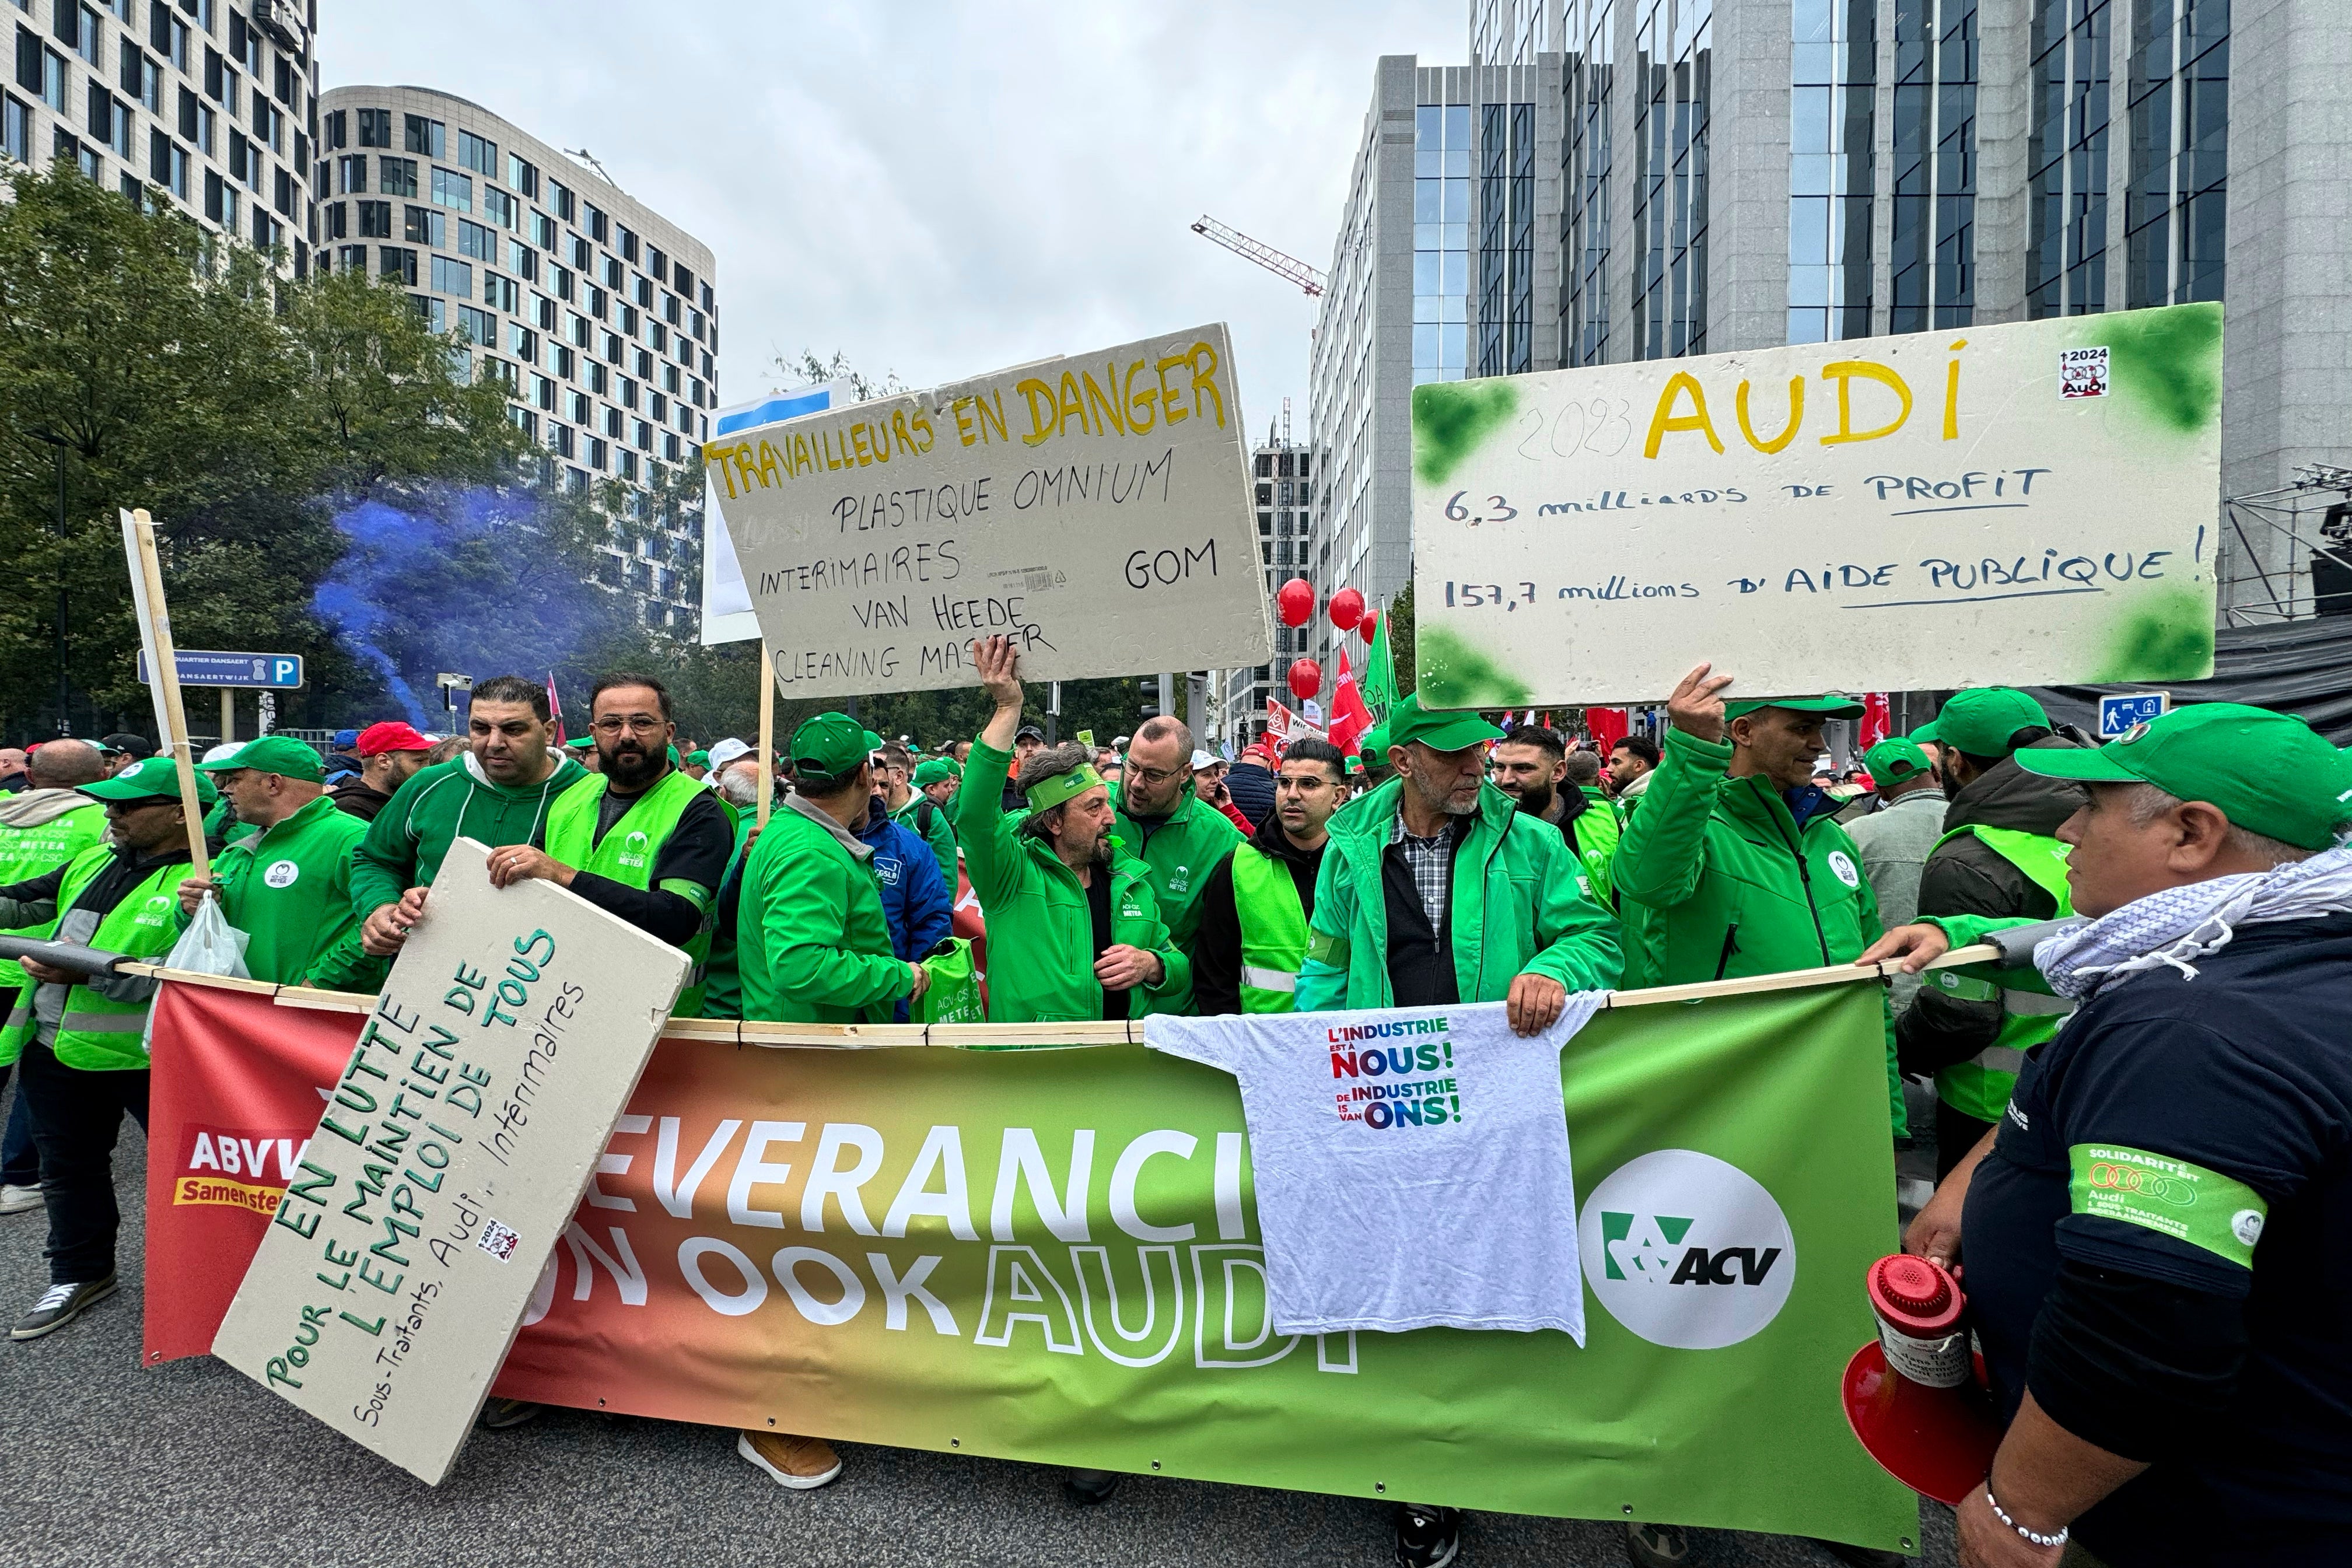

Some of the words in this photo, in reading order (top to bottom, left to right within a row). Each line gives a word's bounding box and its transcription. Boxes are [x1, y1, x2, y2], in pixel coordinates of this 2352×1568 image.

[2069, 348, 2108, 362] 2024
[1644, 338, 1969, 460] AUDI
[702, 405, 935, 500] TRAVAILLEURS
[953, 388, 1010, 447] EN
[1017, 341, 1227, 448] DANGER
[832, 477, 992, 534] PLASTIQUE
[1014, 447, 1173, 510] OMNIUM
[1444, 490, 1518, 528] 6,3
[1780, 484, 1835, 499] DE
[1863, 468, 2053, 501] PROFIT
[760, 539, 961, 596] INTERIMAIRES
[1125, 538, 1219, 589] GOM
[852, 593, 909, 629] VAN
[932, 594, 1027, 631] HEEDE
[1445, 580, 1537, 612] 157,7
[276, 660, 293, 682] P
[775, 645, 901, 684] CLEANING
[20, 841, 65, 850] METEA
[618, 856, 643, 868] METEA
[1168, 882, 1186, 893] METEA
[937, 988, 969, 1012] ACV-CS
[939, 1005, 970, 1024] METE
[443, 1063, 493, 1118] DE
[480, 926, 556, 1028] TOUS
[1328, 1017, 1449, 1042] L'INDUSTRIE
[1329, 1043, 1347, 1052] EST
[1348, 1041, 1356, 1051] À
[1331, 1042, 1454, 1079] NOUS!
[480, 981, 585, 1168] Intérimaires
[1336, 1093, 1351, 1102] DE
[1352, 1077, 1458, 1102] INDUSTRIE
[275, 1158, 338, 1240] EN
[318, 993, 421, 1147] LUTTE
[1338, 1104, 1349, 1113] IS
[1339, 1112, 1363, 1122] VAN
[1364, 1094, 1462, 1130] ONS!
[265, 1302, 332, 1390] POUR
[316, 1237, 360, 1292] LE
[342, 1021, 460, 1224] MAINTIEN
[443, 959, 488, 1017] DE
[585, 1113, 1248, 1243] EVERANCI
[2088, 1189, 2126, 1203] Audi
[481, 1219, 498, 1244] 2024
[1668, 1247, 1782, 1286] ACV
[677, 1235, 961, 1337] OOK
